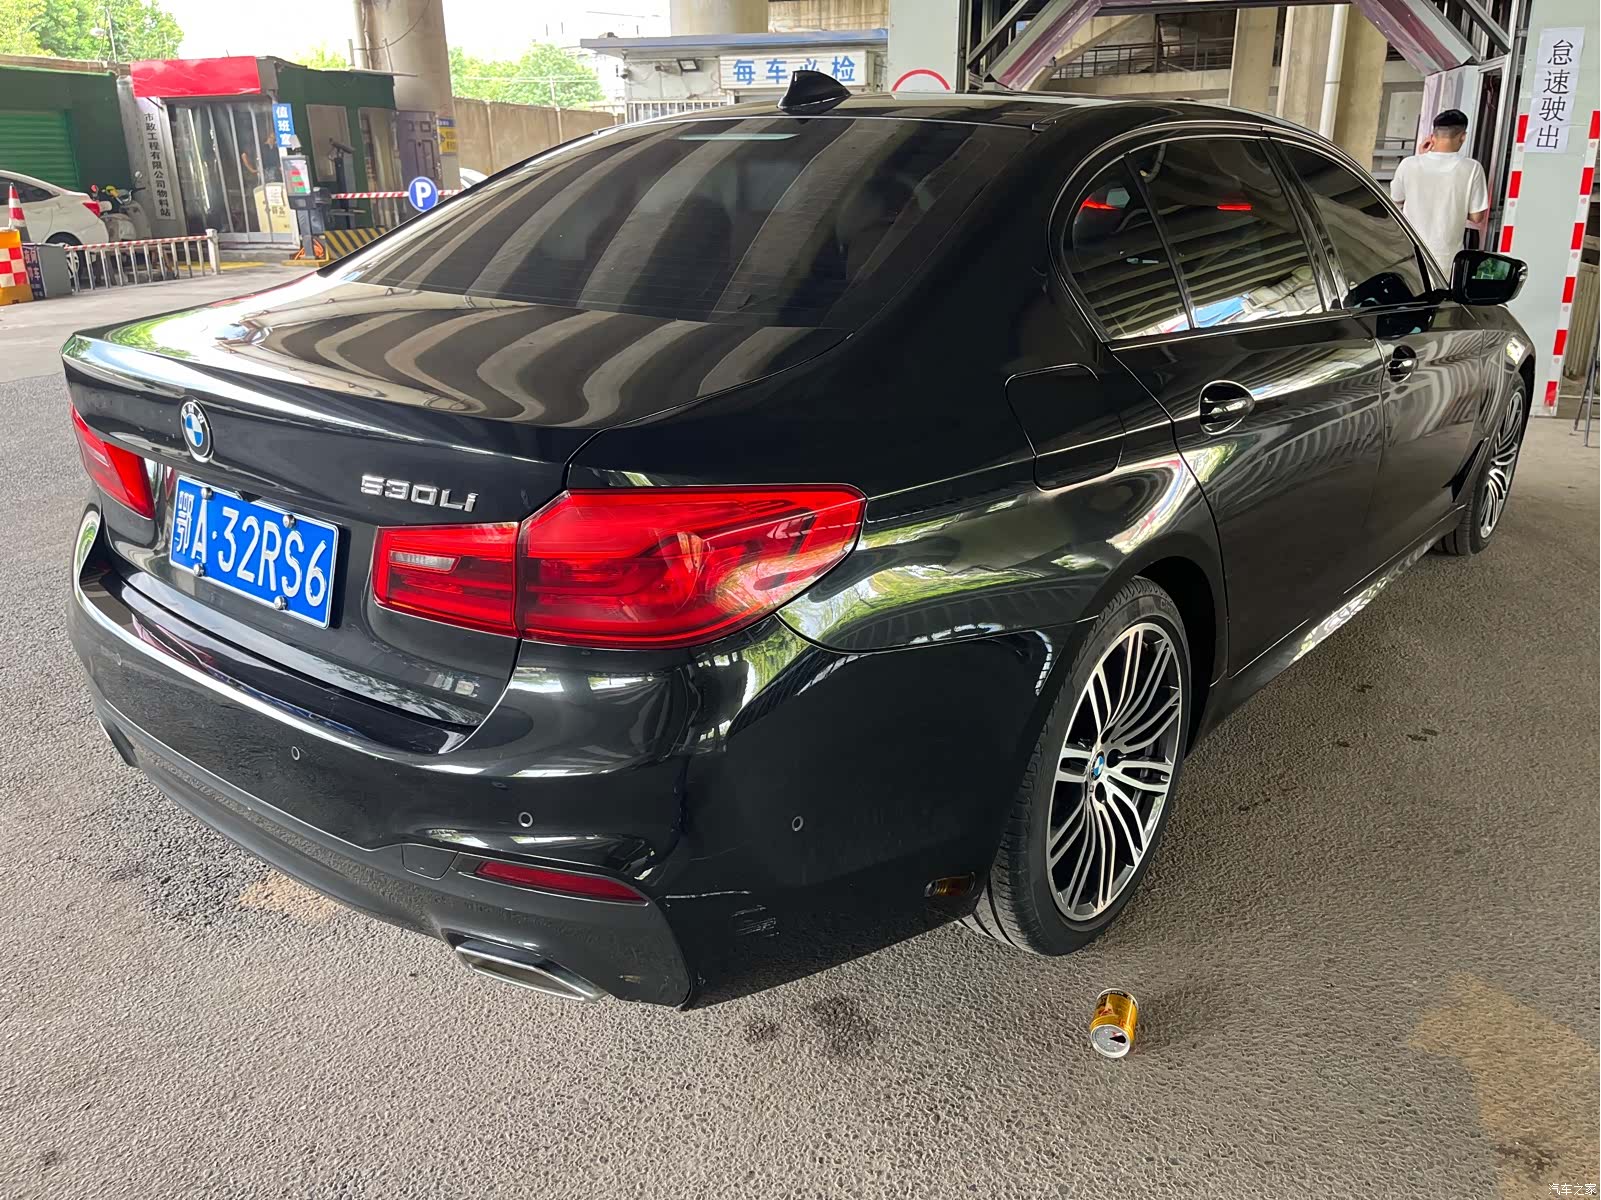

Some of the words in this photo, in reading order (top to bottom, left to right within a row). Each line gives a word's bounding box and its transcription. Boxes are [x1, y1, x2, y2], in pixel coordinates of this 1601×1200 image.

[1536, 39, 1574, 149] 怠速驶出
[415, 181, 432, 207] P
